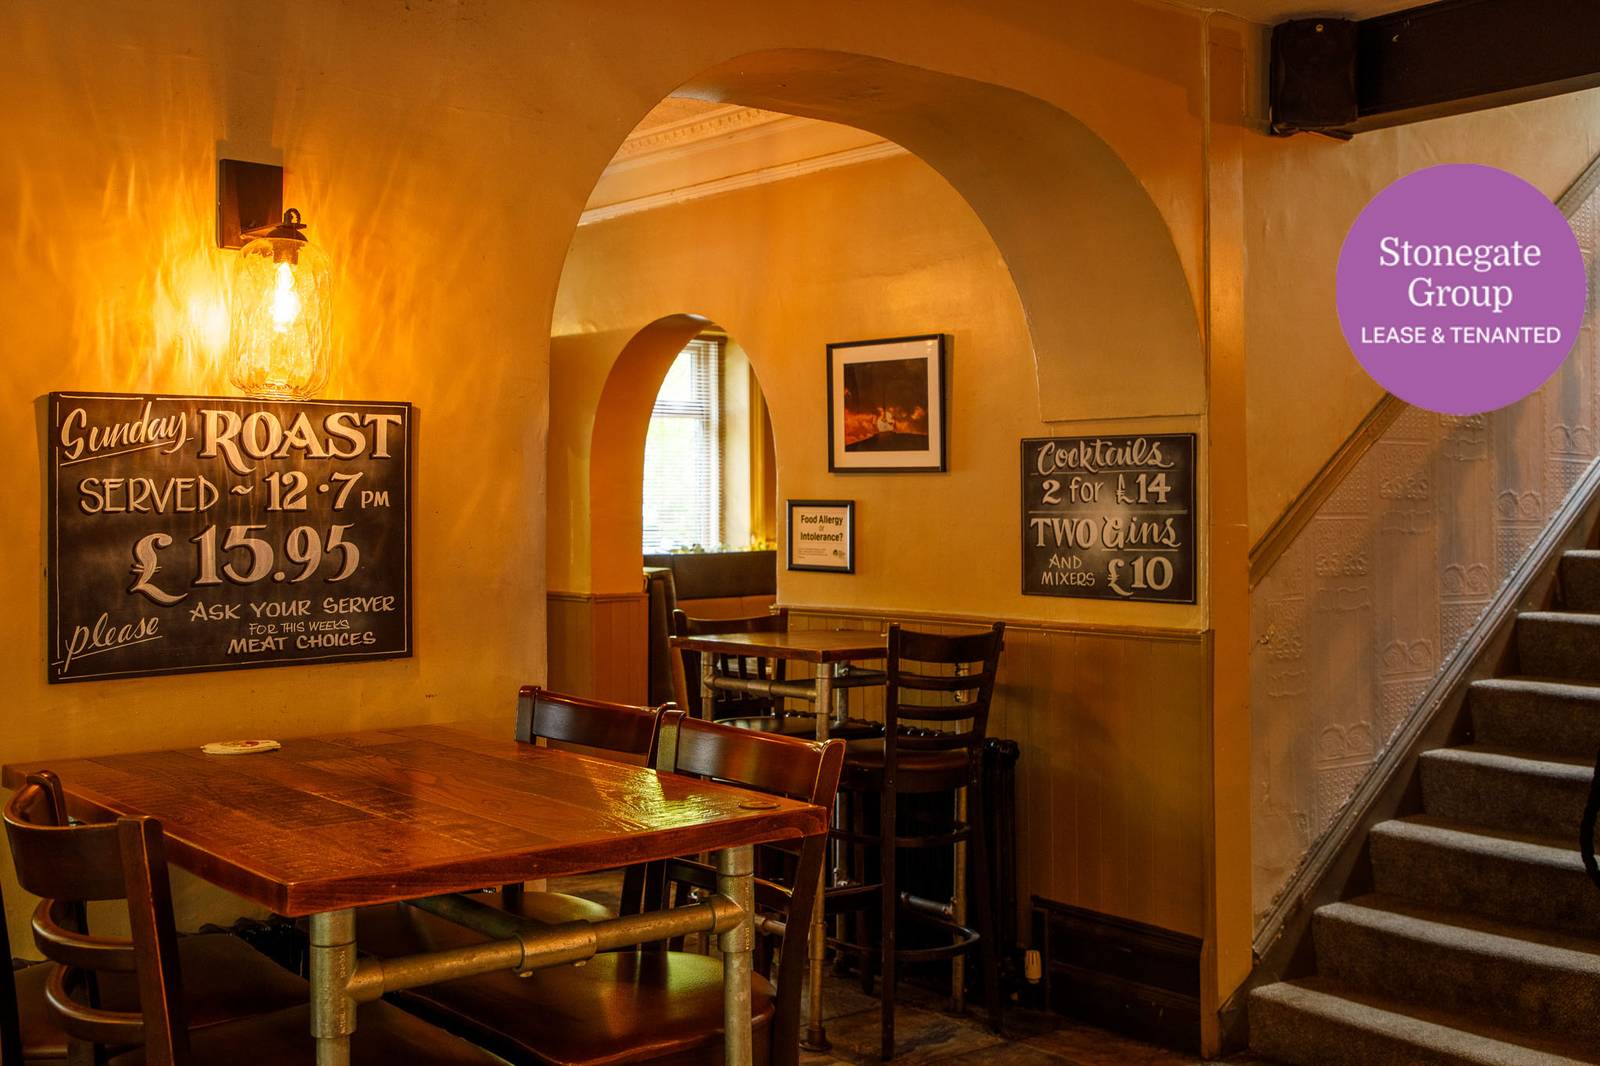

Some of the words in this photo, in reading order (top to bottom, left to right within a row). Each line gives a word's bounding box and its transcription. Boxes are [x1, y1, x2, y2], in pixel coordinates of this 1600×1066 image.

[60, 402, 188, 460] Sunday
[200, 408, 402, 475] ROAST
[1037, 437, 1174, 476] Cocktails
[79, 475, 220, 513] SERVED
[361, 489, 390, 508] PM
[1042, 479, 1062, 505] 2
[1069, 476, 1104, 503] for
[1116, 473, 1171, 504] £14
[800, 514, 818, 524] Food
[818, 514, 843, 526] Allergy
[1030, 517, 1099, 549] TWO
[1101, 515, 1182, 549] Gins
[800, 532, 843, 541] Intolerance?
[129, 523, 361, 604] £15.95
[1049, 553, 1082, 569] AND
[1107, 555, 1174, 597] £10
[1041, 571, 1096, 586] MIXERS
[191, 601, 241, 621] ASK
[250, 599, 311, 618] YOUR
[323, 596, 396, 614] SERVER
[64, 612, 160, 672] please
[227, 636, 288, 654] MEAT
[296, 631, 377, 649] CHOICES
[249, 622, 279, 635] FOR
[281, 621, 305, 633] THIS
[308, 619, 351, 631] WEEKS
